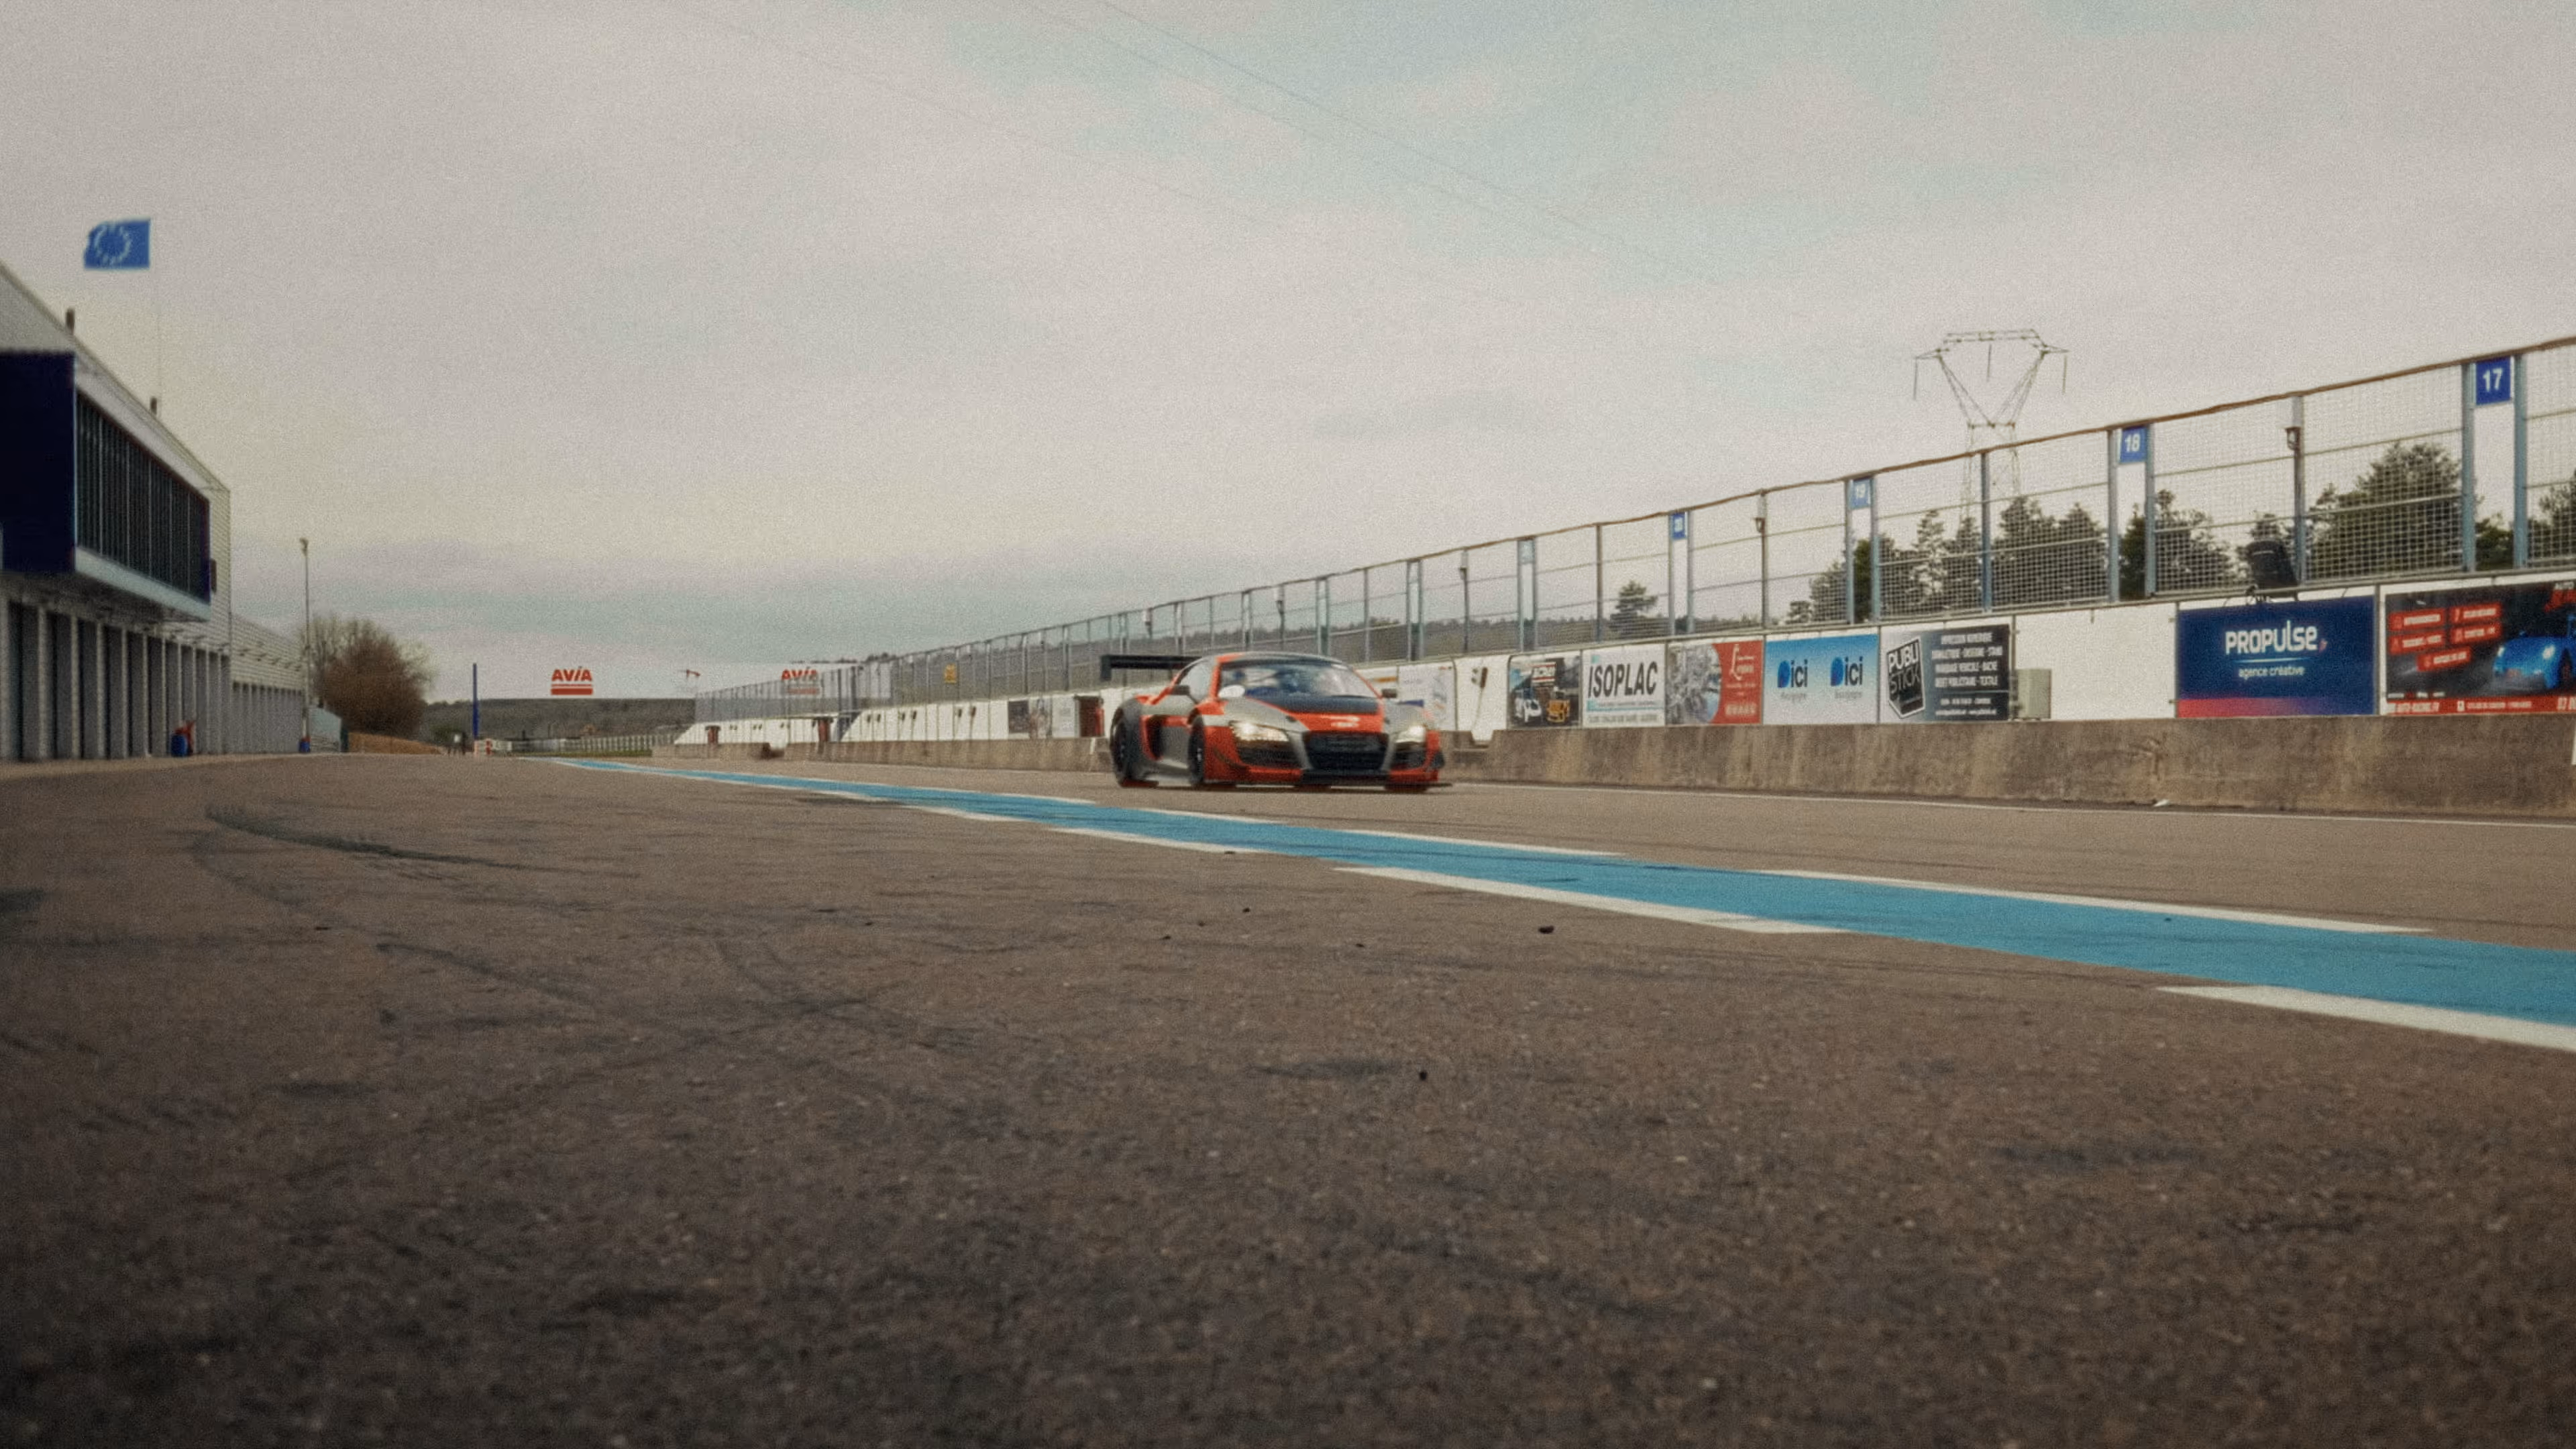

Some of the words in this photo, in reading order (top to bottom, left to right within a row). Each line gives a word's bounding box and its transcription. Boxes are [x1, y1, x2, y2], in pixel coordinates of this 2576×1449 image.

[2482, 368, 2502, 392] 17
[2124, 433, 2141, 453] 18
[551, 667, 592, 682] AVIA
[1587, 661, 1658, 698] ISOPLAC
[1790, 659, 1808, 688] ici
[1845, 656, 1864, 686] ici
[1888, 662, 1921, 695] STICK
